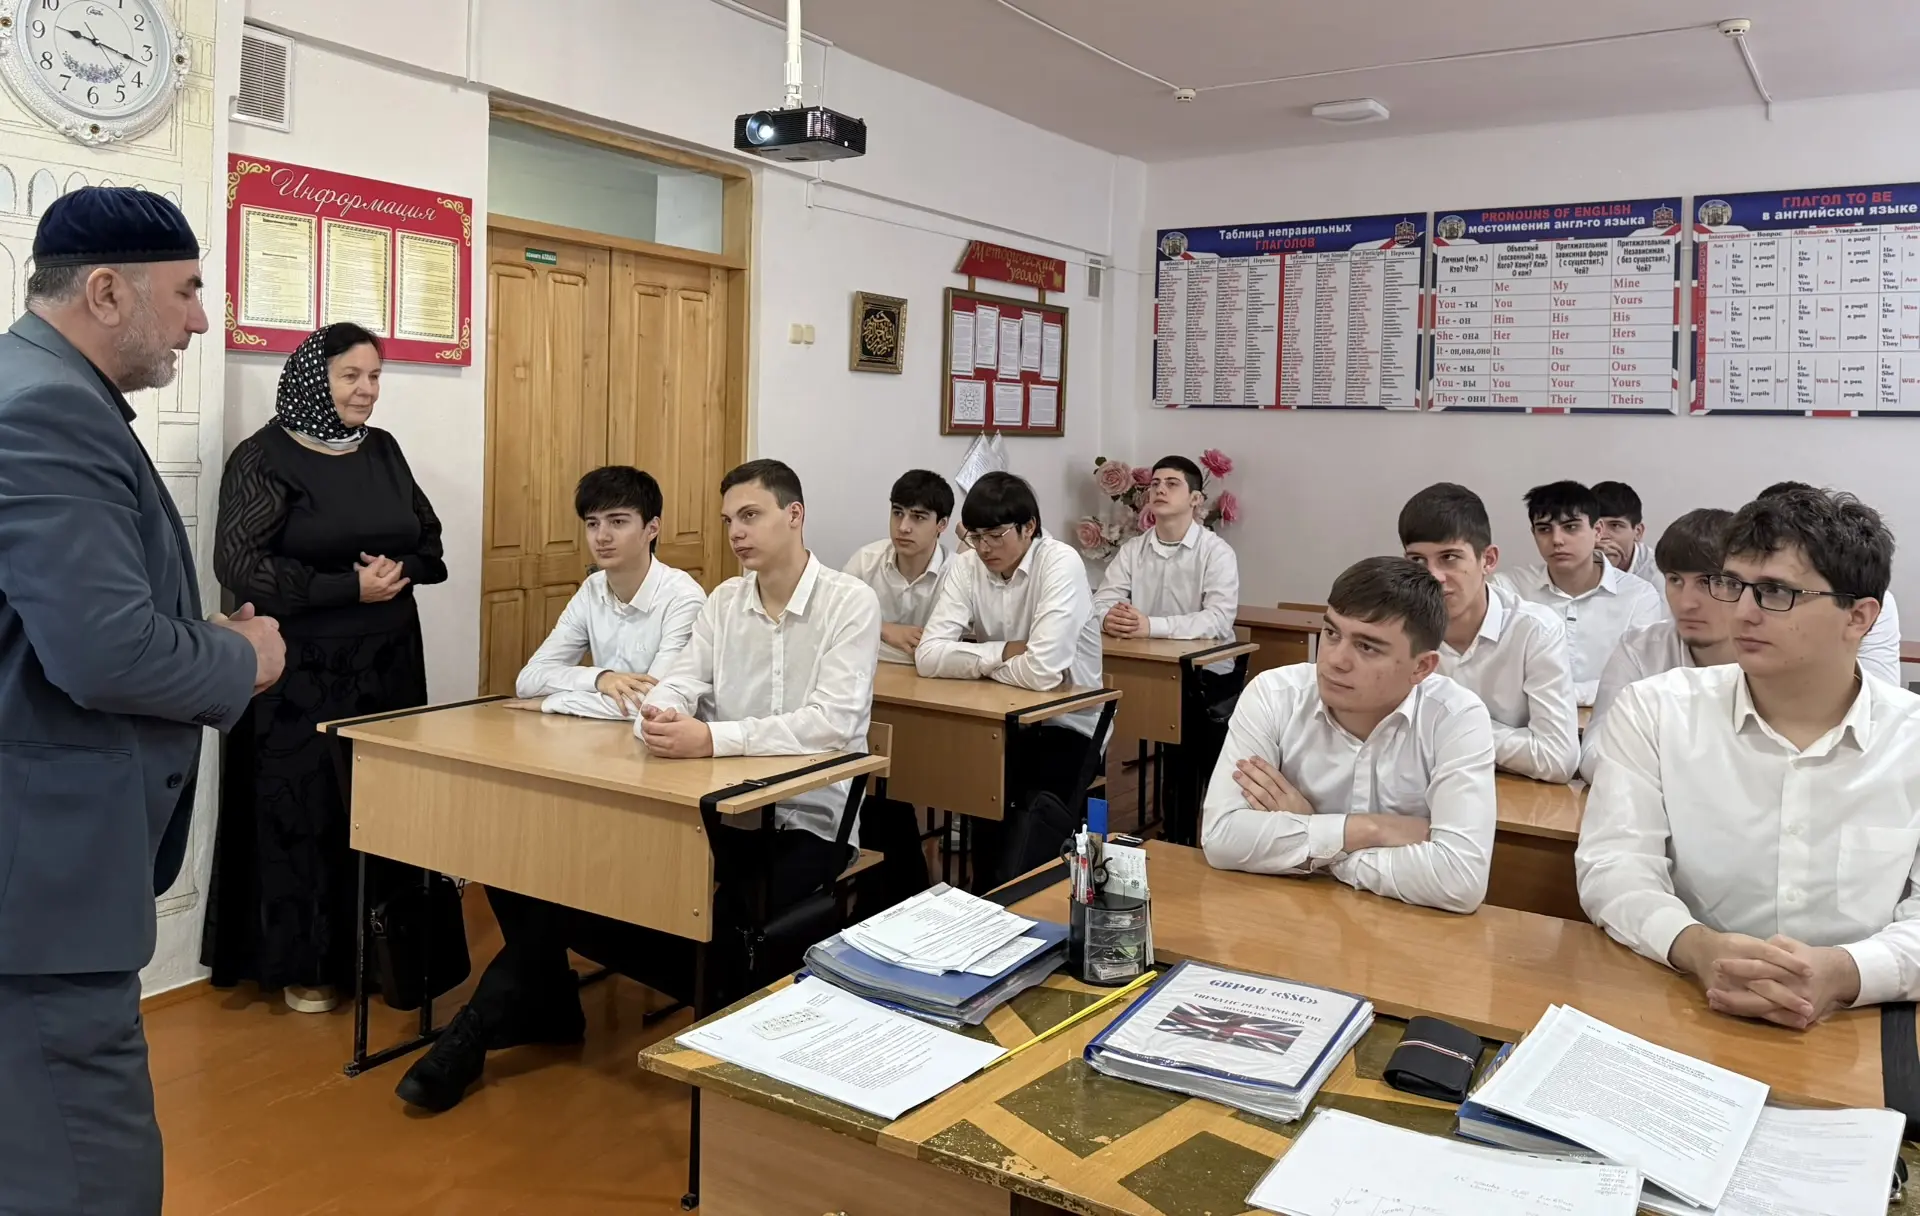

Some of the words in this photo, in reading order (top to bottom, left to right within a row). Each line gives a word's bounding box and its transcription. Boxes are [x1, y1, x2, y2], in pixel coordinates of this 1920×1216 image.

[133, 14, 144, 31] 2
[32, 20, 45, 38] 9
[141, 45, 153, 61] 3
[40, 51, 52, 70] 8
[60, 74, 71, 90] 7
[131, 71, 143, 88] 4
[87, 86, 99, 104] 6
[115, 85, 125, 102] 5
[270, 168, 436, 221] Информация
[1782, 195, 1841, 208] ГЛАГОЛ
[1482, 209, 1550, 222] PRONOUNS
[1554, 208, 1570, 218] OF
[1574, 204, 1631, 217] ENGLISH
[1762, 212, 1770, 221] в
[1775, 207, 1864, 220] английском
[1869, 204, 1917, 216] языке
[1469, 222, 1550, 234] местоимения
[1554, 220, 1600, 229] англ-го
[1604, 217, 1645, 227] языка
[1220, 229, 1265, 240] Таблица
[1268, 224, 1352, 238] неправильных
[1256, 238, 1316, 251] ГЛАГОЛОВ
[1007, 267, 1048, 288] уголок
[1495, 282, 1510, 292] Me
[1553, 280, 1569, 293] My
[1614, 278, 1641, 288] Mine
[1438, 299, 1456, 309] You
[1494, 298, 1513, 308] You
[1553, 297, 1576, 307] Your
[1614, 295, 1643, 305] Yours
[1437, 315, 1450, 325] He
[1459, 317, 1471, 325] он
[1493, 314, 1514, 324] Him
[1552, 312, 1569, 323] His
[1613, 312, 1631, 322] His
[1436, 331, 1454, 340] She
[1462, 332, 1480, 340] она
[1493, 330, 1511, 340] Her
[1552, 330, 1570, 340] Her
[1612, 328, 1636, 338] Hers
[1436, 346, 1443, 355] It
[1493, 346, 1501, 356] It
[1551, 345, 1564, 355] Its
[1612, 345, 1625, 355] Its
[1436, 363, 1451, 372] We
[1492, 362, 1505, 372] Us
[1551, 362, 1571, 372] Our
[1612, 361, 1637, 371] Ours
[1436, 378, 1454, 388] You
[1463, 380, 1476, 388] вы
[1492, 378, 1511, 388] You
[1551, 378, 1575, 388] Your
[1612, 377, 1641, 387] Yours
[1436, 393, 1459, 405] They
[1467, 395, 1486, 403] они
[1492, 393, 1518, 403] Them
[1550, 394, 1577, 404] Their
[1611, 394, 1644, 404] Theirs
[1209, 979, 1268, 995] GBPOU
